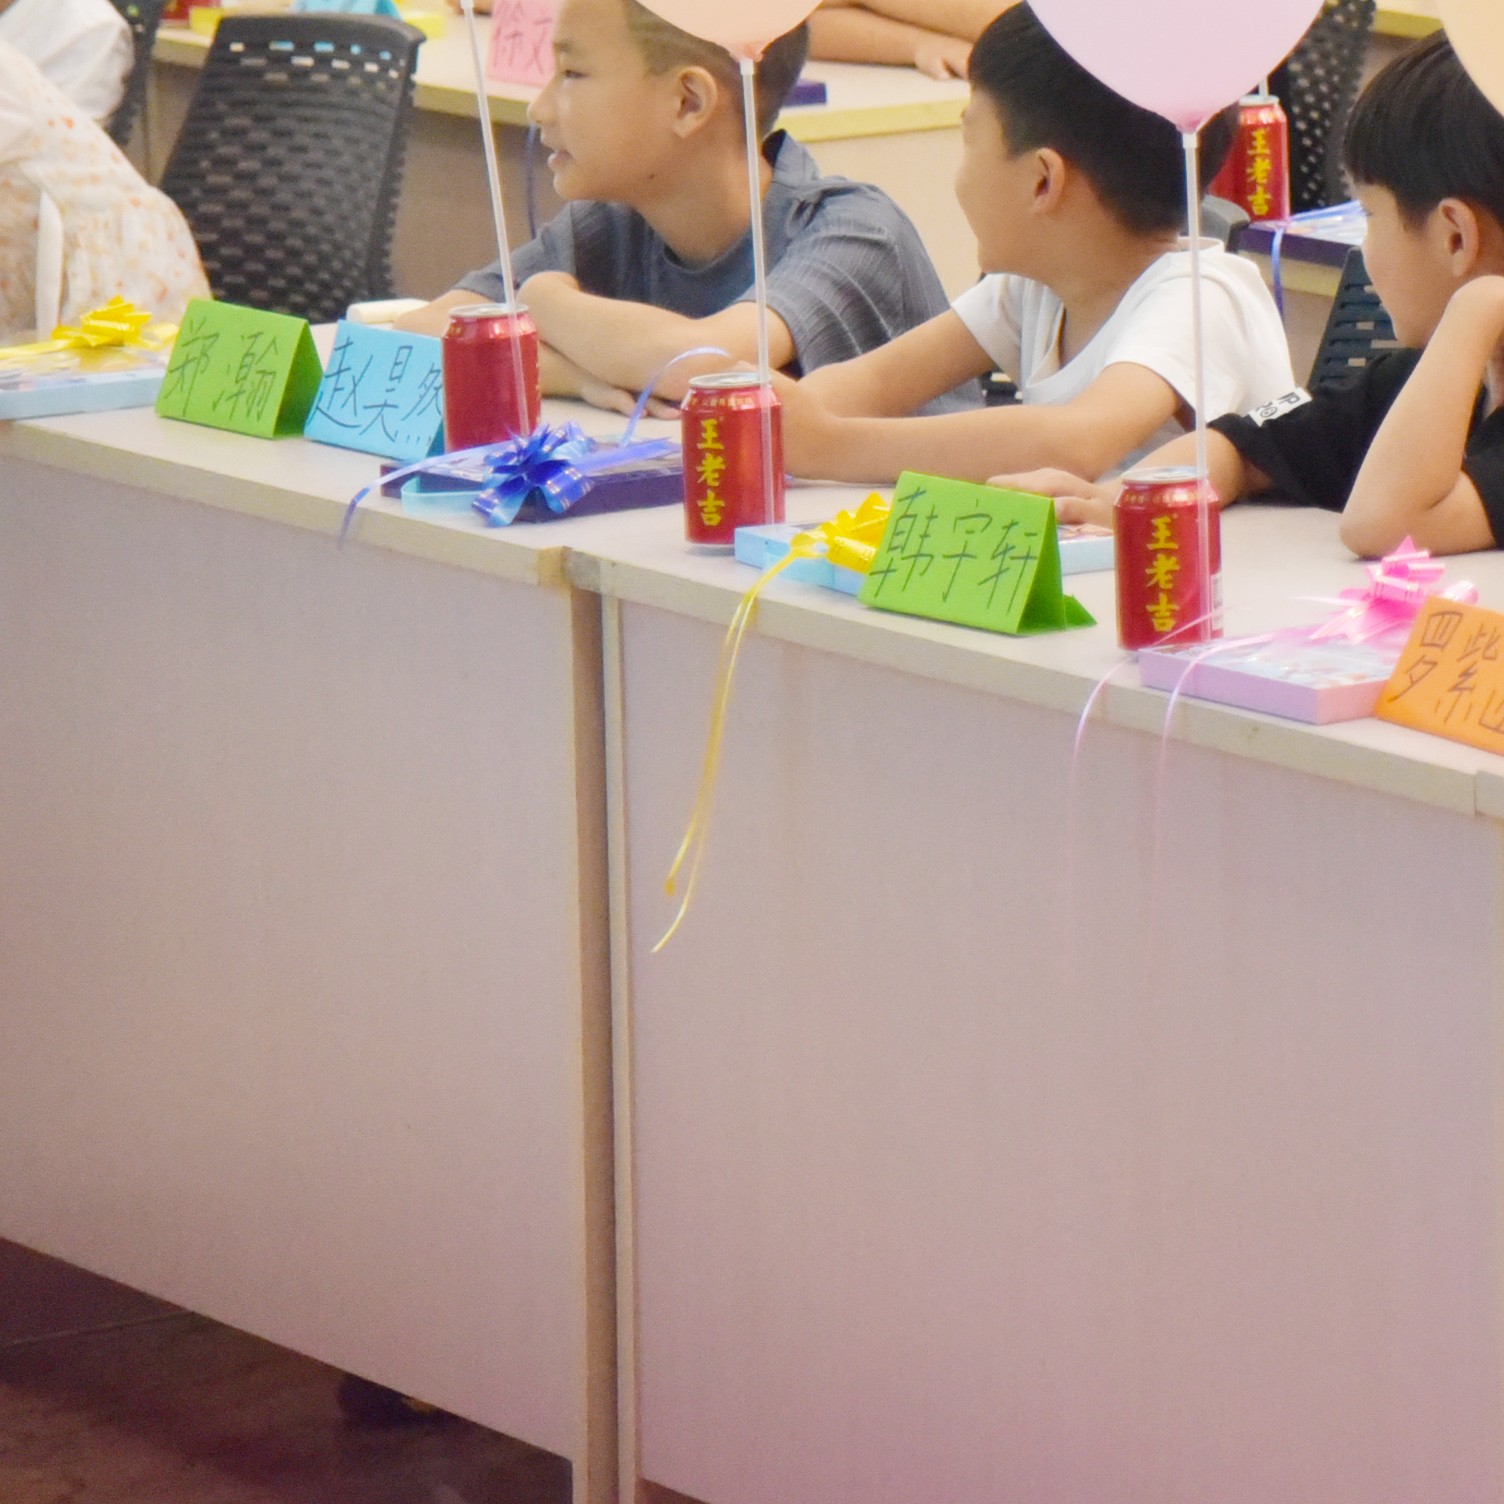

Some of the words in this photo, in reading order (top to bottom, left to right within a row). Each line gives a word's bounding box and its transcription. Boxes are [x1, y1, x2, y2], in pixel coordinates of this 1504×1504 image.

[1247, 128, 1271, 216] 王老吉
[697, 418, 726, 527] 王老吉
[1145, 515, 1180, 632] 王老吉
